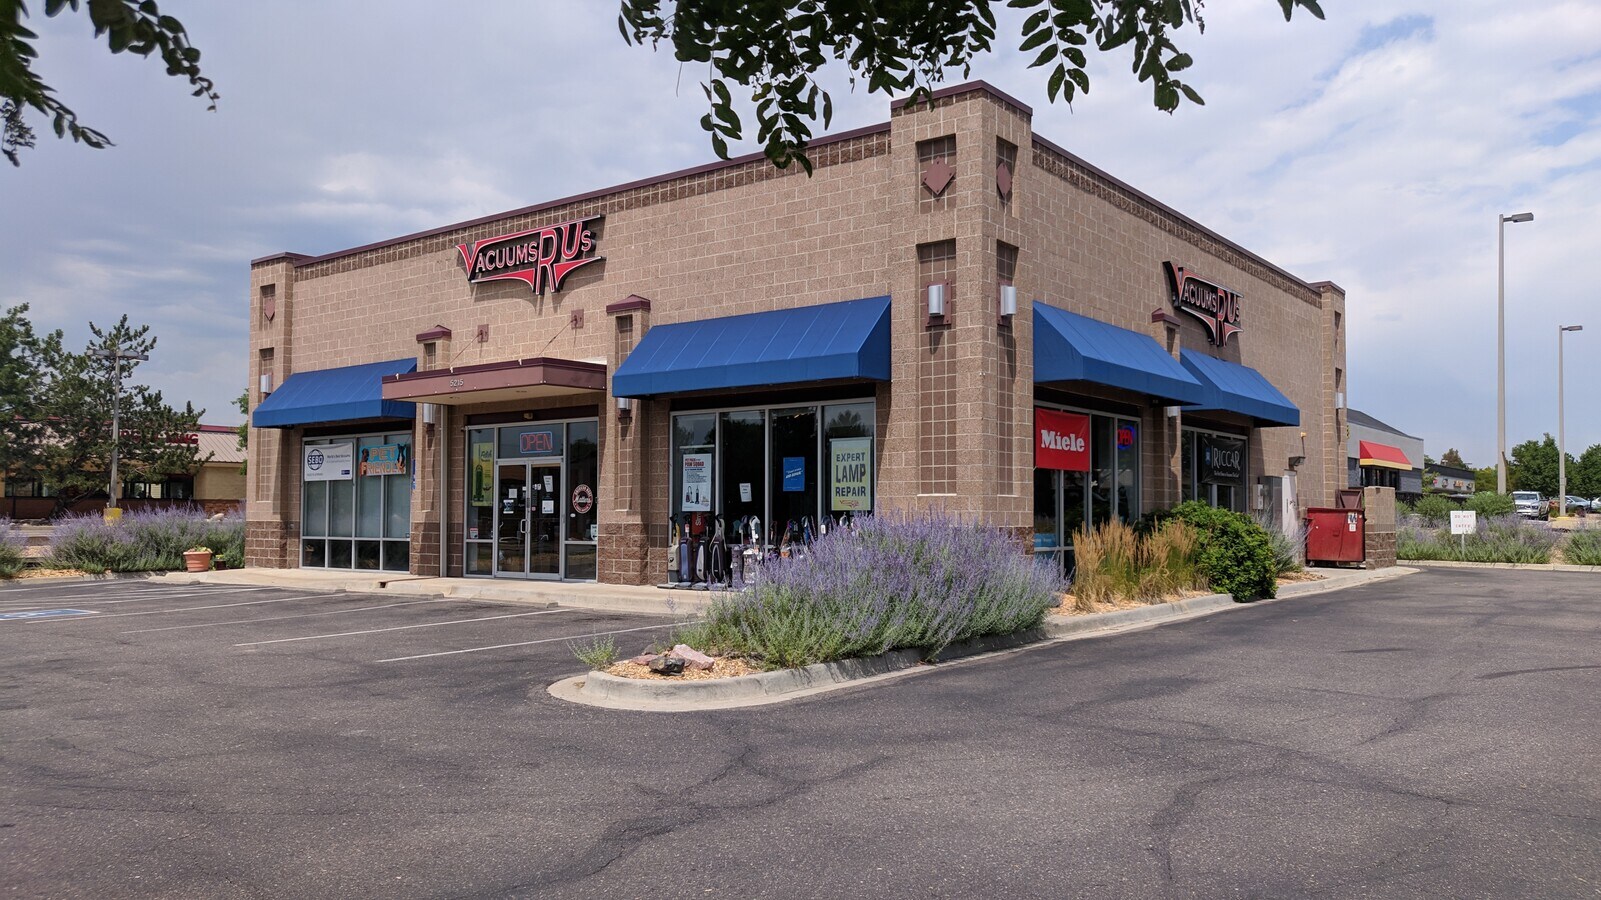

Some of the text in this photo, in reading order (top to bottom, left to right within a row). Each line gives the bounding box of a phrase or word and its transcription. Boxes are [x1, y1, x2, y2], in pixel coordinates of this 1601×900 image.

[535, 228, 556, 295] R
[1217, 287, 1227, 347] R
[450, 378, 464, 387] 5215
[521, 433, 553, 451] OPEN
[1040, 429, 1085, 452] Miele
[308, 455, 323, 465] SEBO
[369, 447, 395, 460] PET
[836, 452, 866, 462] EXPERT
[1213, 447, 1240, 470] RICCAR
[835, 463, 866, 484] LAMP
[835, 486, 866, 497] REPAIR
